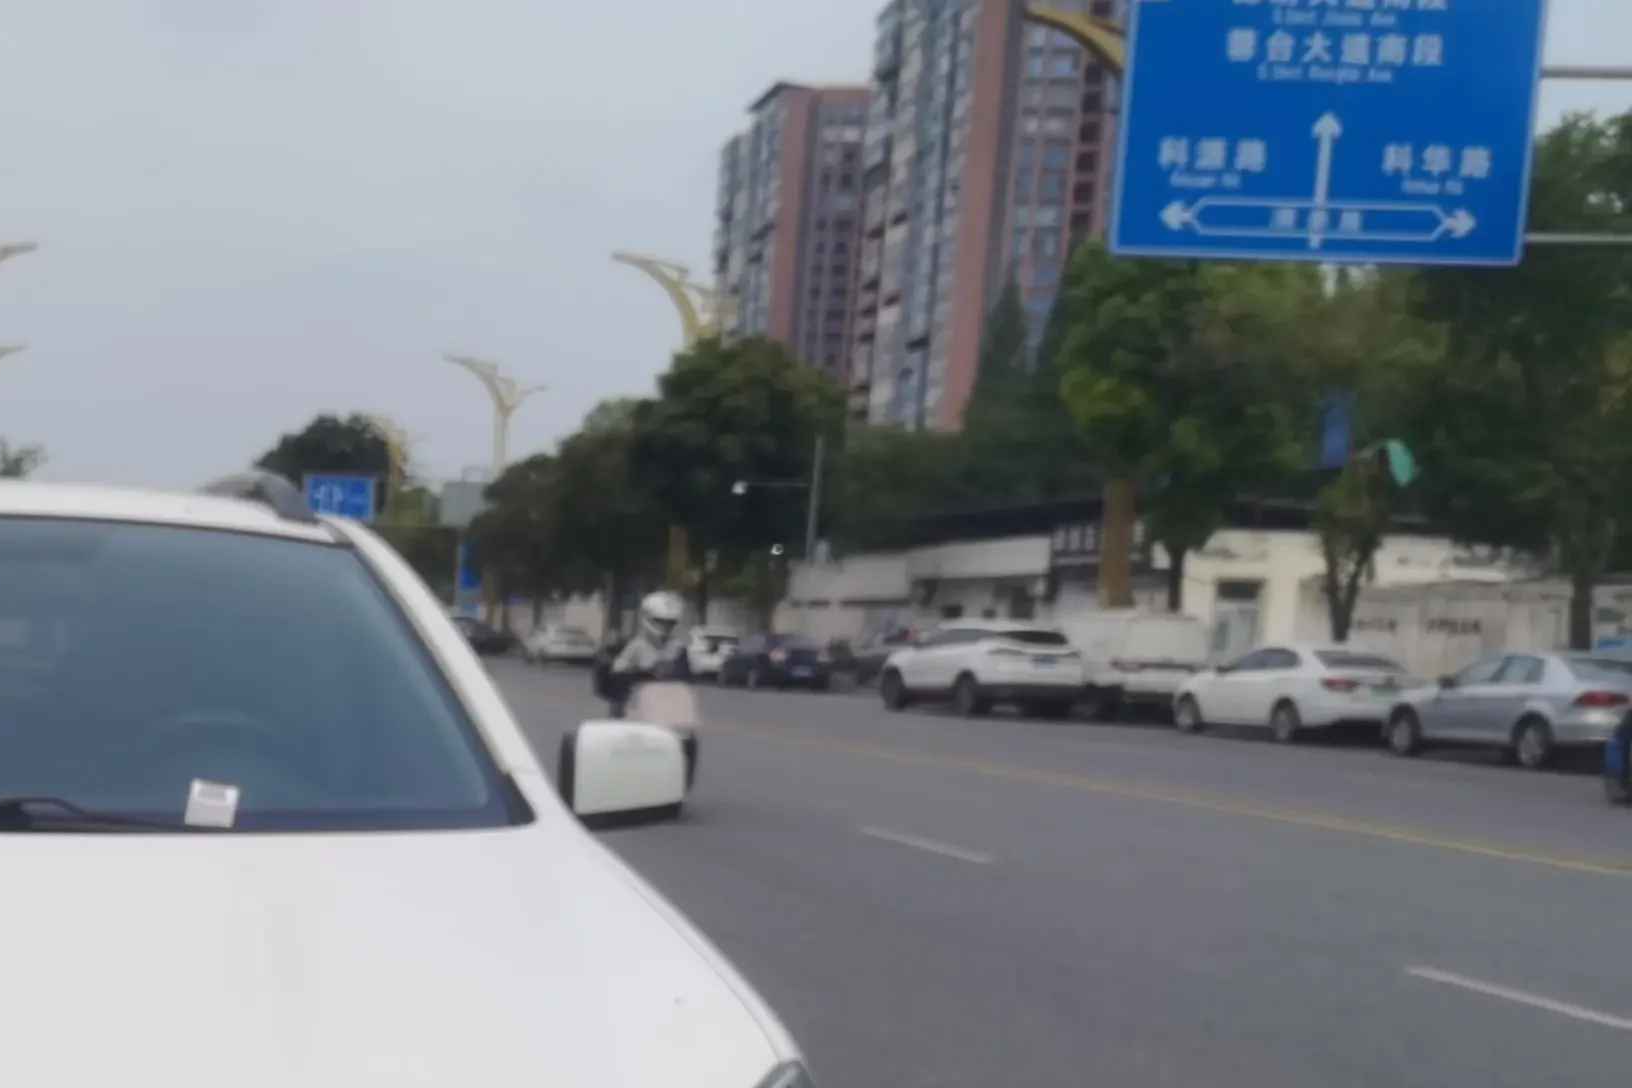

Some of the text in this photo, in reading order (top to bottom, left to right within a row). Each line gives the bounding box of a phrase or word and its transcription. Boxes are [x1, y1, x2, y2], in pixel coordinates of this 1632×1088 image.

[1227, 27, 1443, 66] 台大道南段
